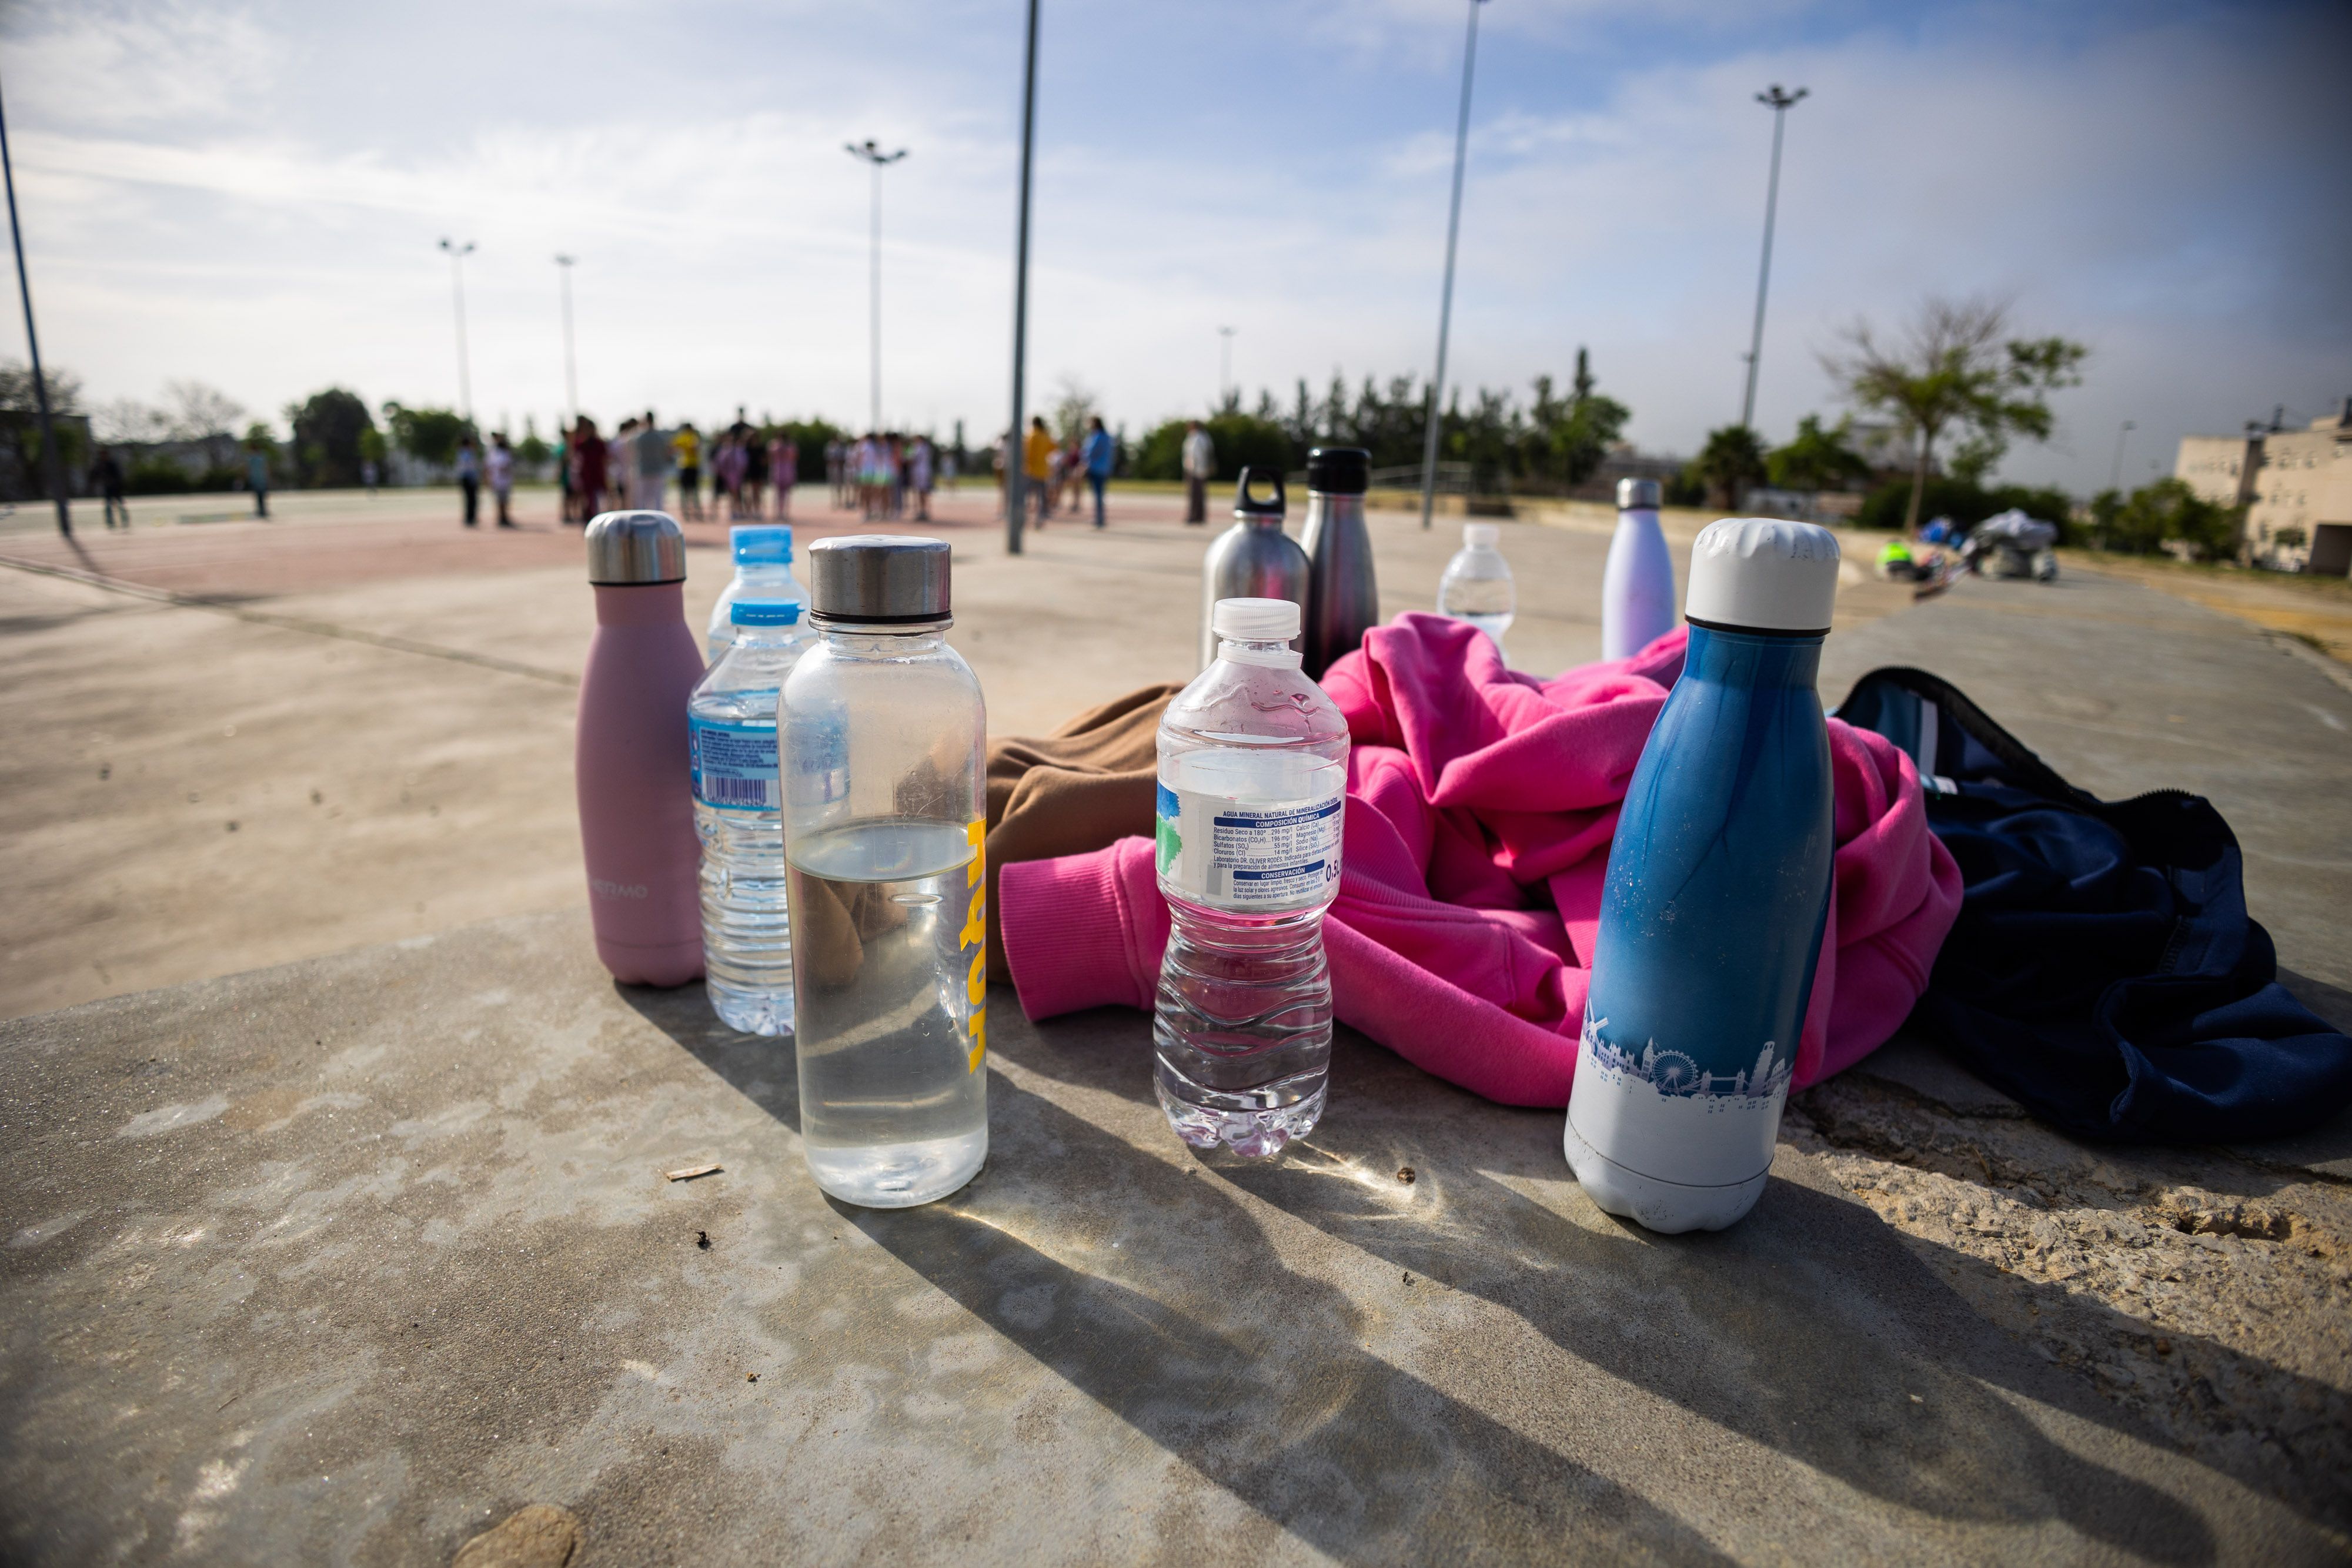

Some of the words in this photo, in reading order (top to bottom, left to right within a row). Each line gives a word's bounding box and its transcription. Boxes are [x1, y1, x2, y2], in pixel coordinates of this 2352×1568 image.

[1264, 810, 1288, 818] NATURAL
[1296, 801, 1330, 814] MINERALIZACIÓN
[1255, 817, 1297, 828] COMPOSICIÓN
[1298, 813, 1320, 823] QUÍMICA
[1311, 821, 1319, 830] (Ca)
[1296, 830, 1317, 838] Magnesio
[1317, 825, 1326, 834] (Mg)
[1281, 840, 1292, 848] mg/l
[1296, 837, 1309, 845] Sodio
[1309, 835, 1318, 844] (Na)
[1311, 848, 1321, 856] dietas
[1261, 867, 1305, 879] CONSERVACIÓN
